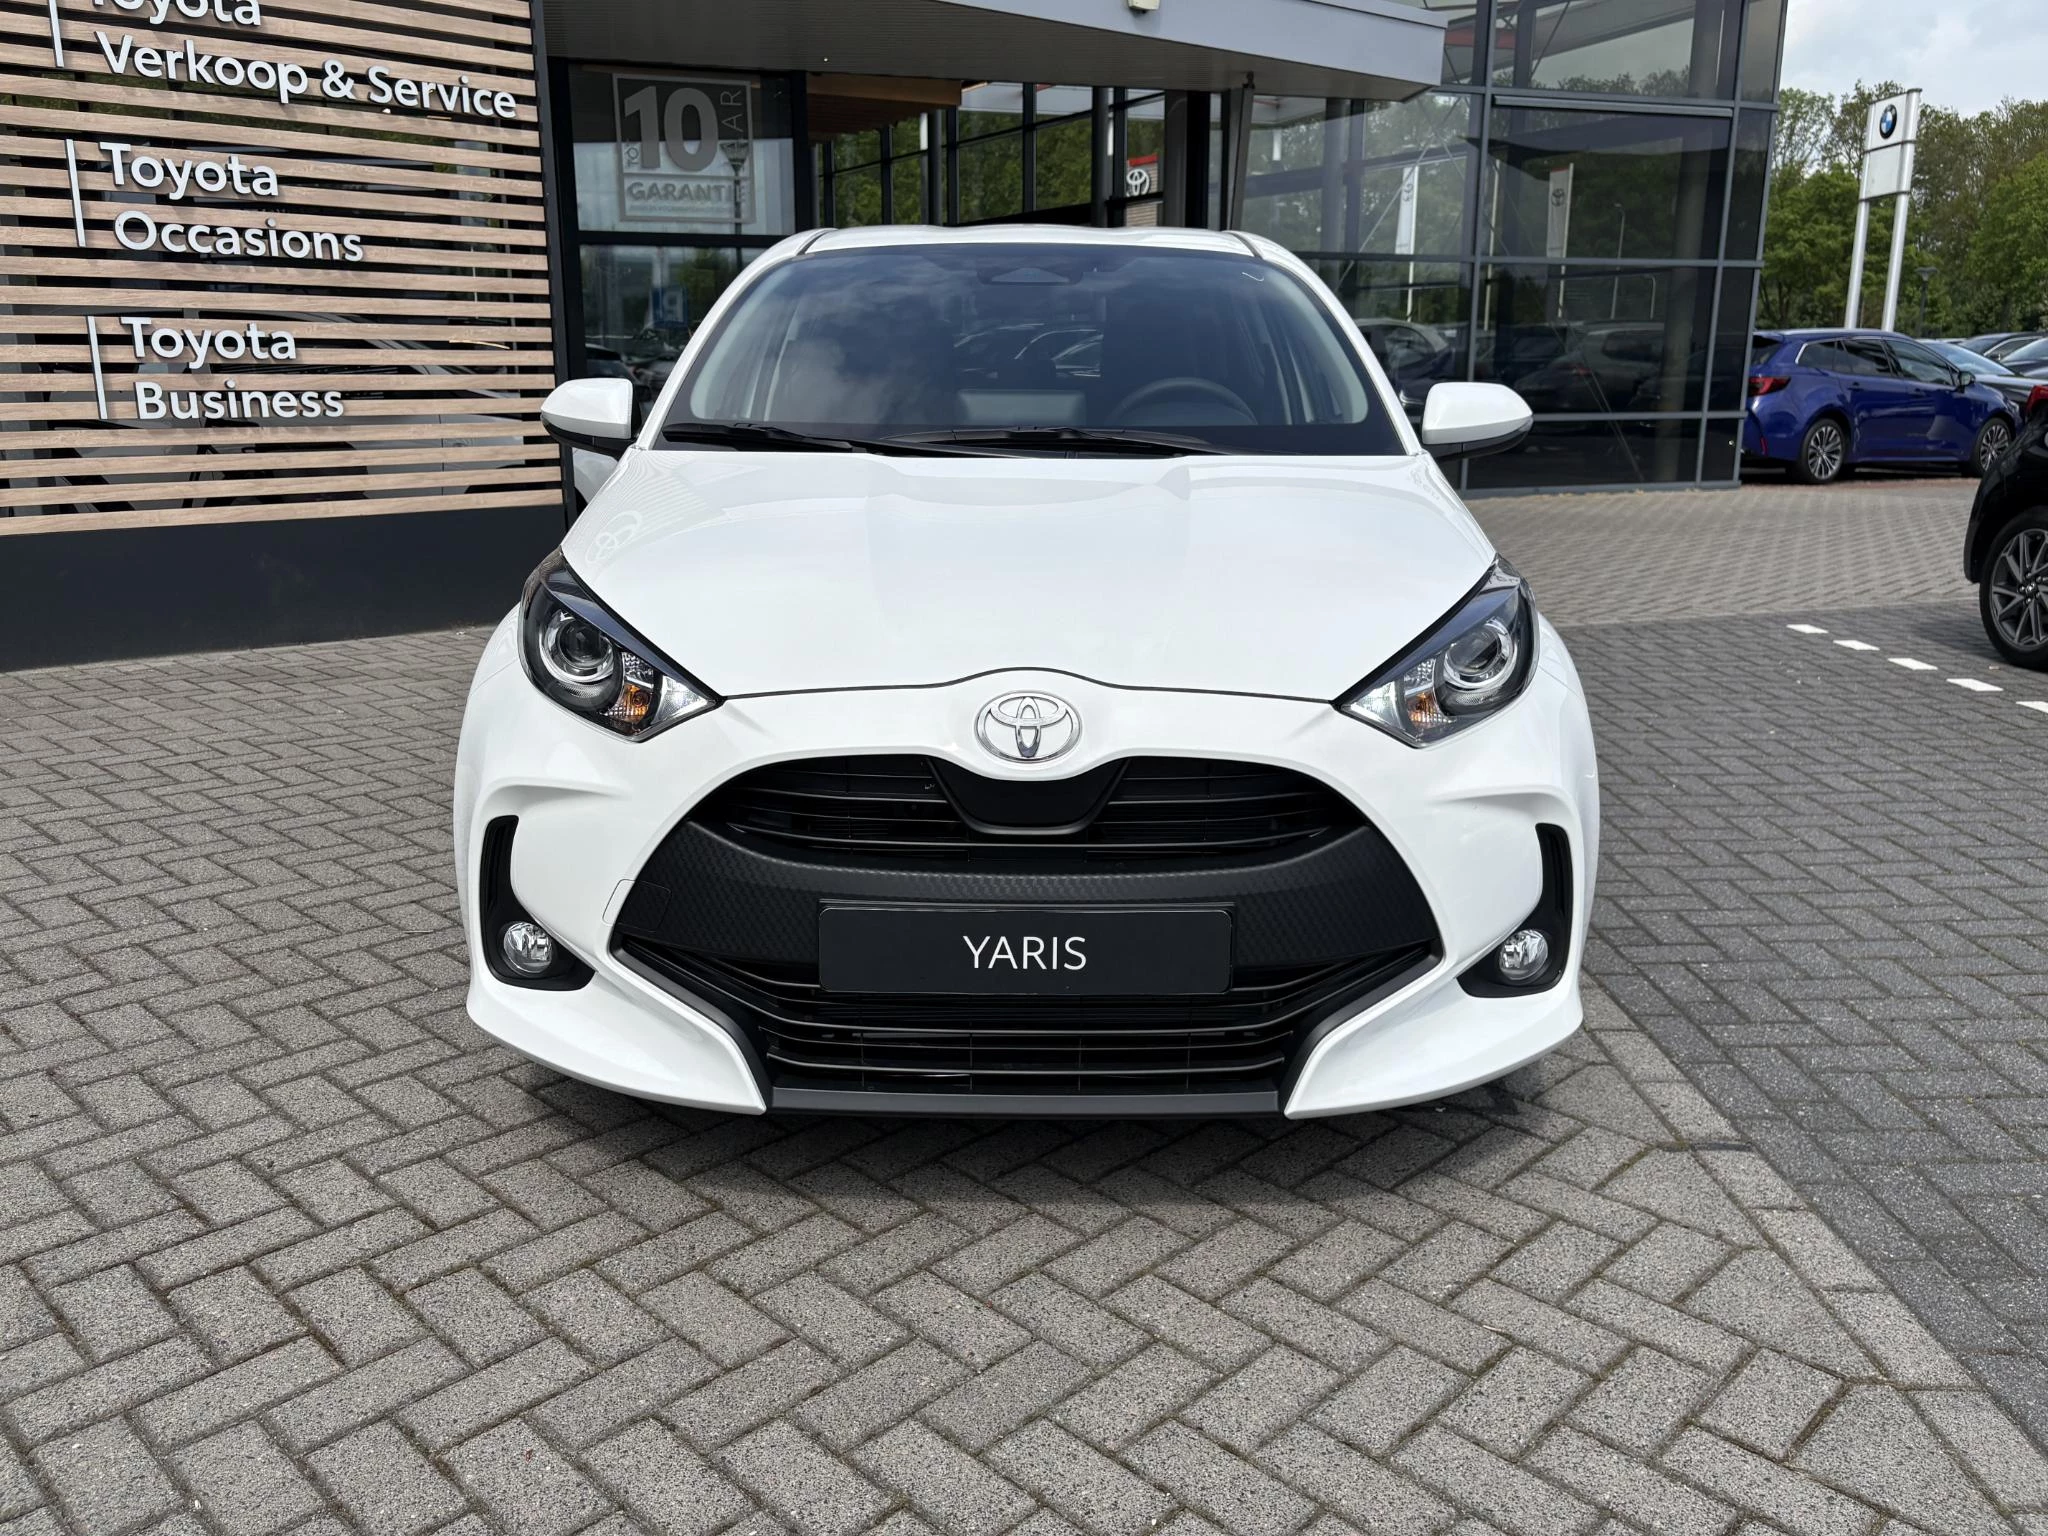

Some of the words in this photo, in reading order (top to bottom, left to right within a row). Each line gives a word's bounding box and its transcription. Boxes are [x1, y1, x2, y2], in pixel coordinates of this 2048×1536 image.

[94, 0, 261, 25] yota
[96, 31, 309, 103] Verkoop
[322, 59, 355, 99] &
[368, 66, 517, 118] Service
[624, 85, 719, 172] 10
[100, 142, 279, 200] Toyota
[115, 210, 363, 262] Occasions
[121, 317, 297, 368] Toyota
[135, 379, 344, 420] Business
[963, 935, 1087, 970] YARIS
